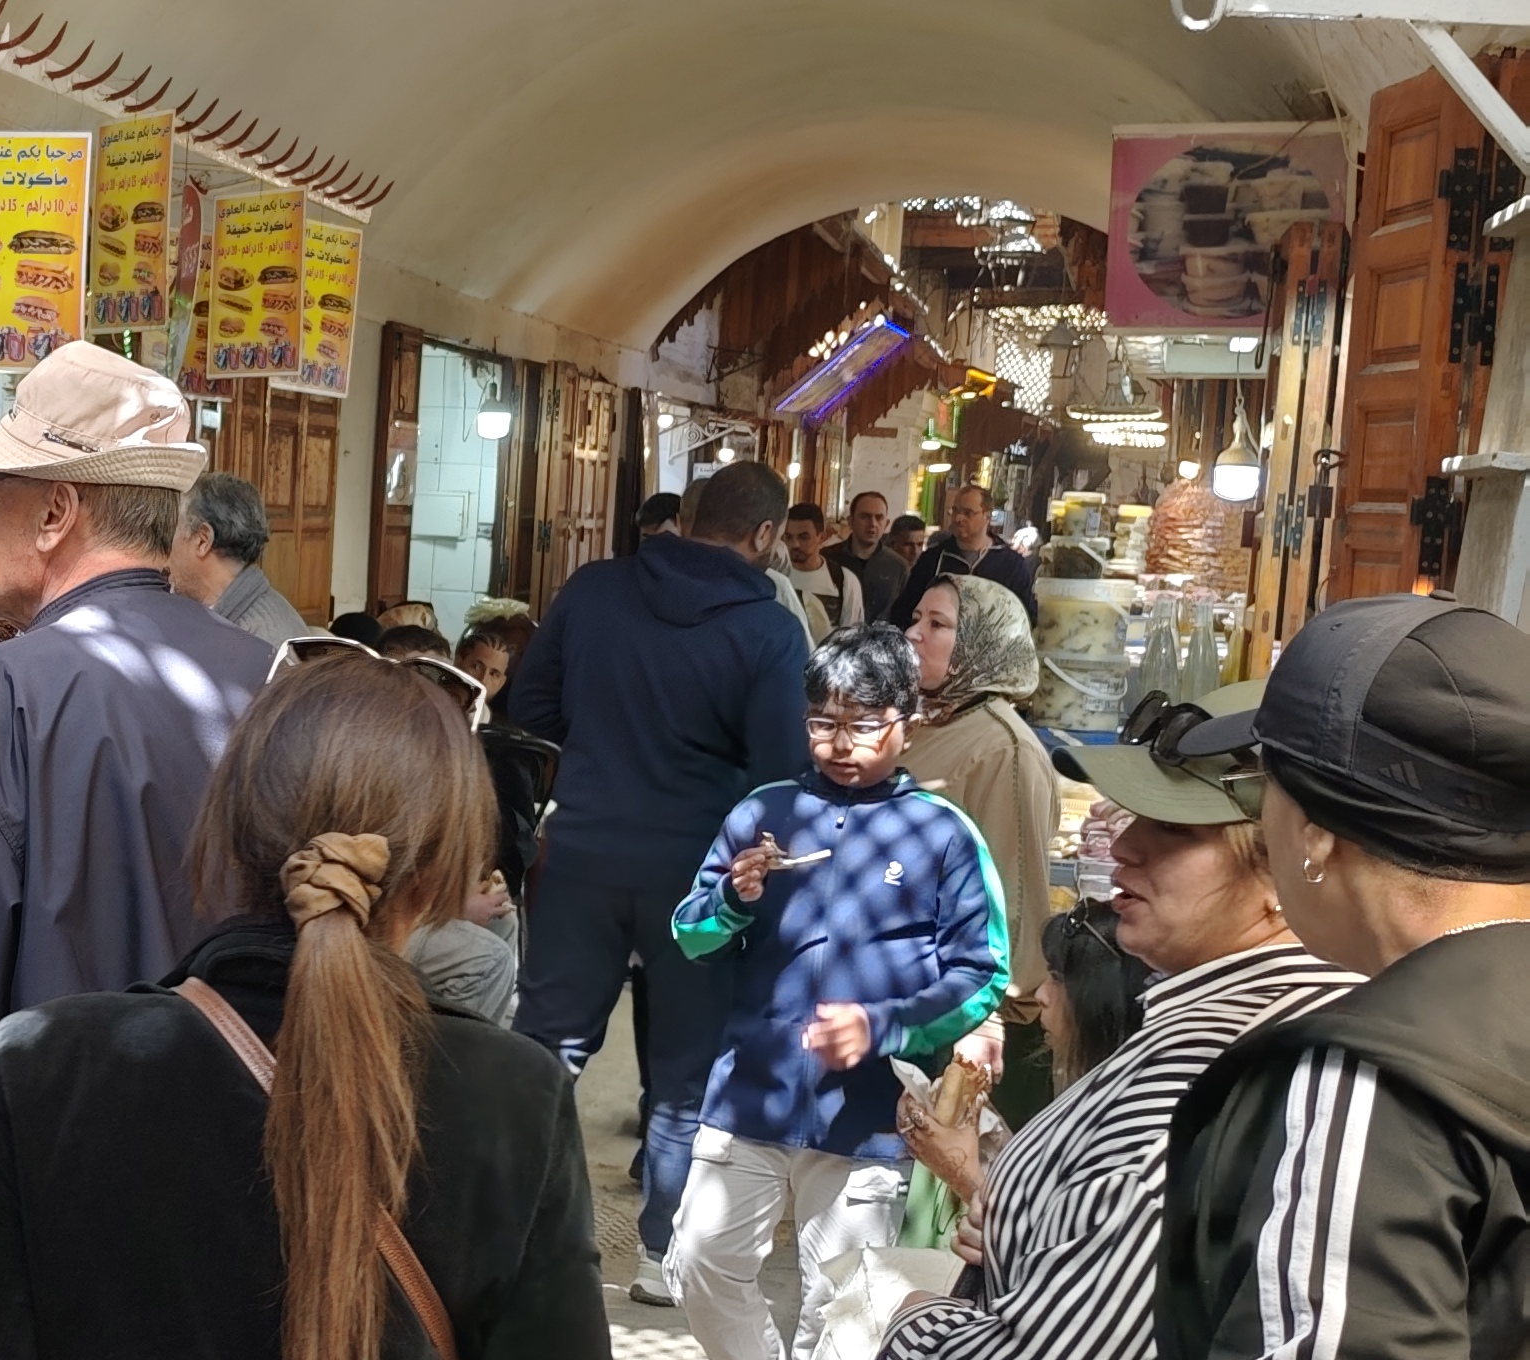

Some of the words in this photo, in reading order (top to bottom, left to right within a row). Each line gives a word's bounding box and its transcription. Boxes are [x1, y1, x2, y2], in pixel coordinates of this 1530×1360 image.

[16, 144, 42, 163] بكم
[44, 144, 84, 163] مرحبا
[1, 169, 68, 189] مأكولات
[8, 198, 17, 212] 15
[26, 195, 52, 218] دراهم
[53, 198, 64, 213] 10
